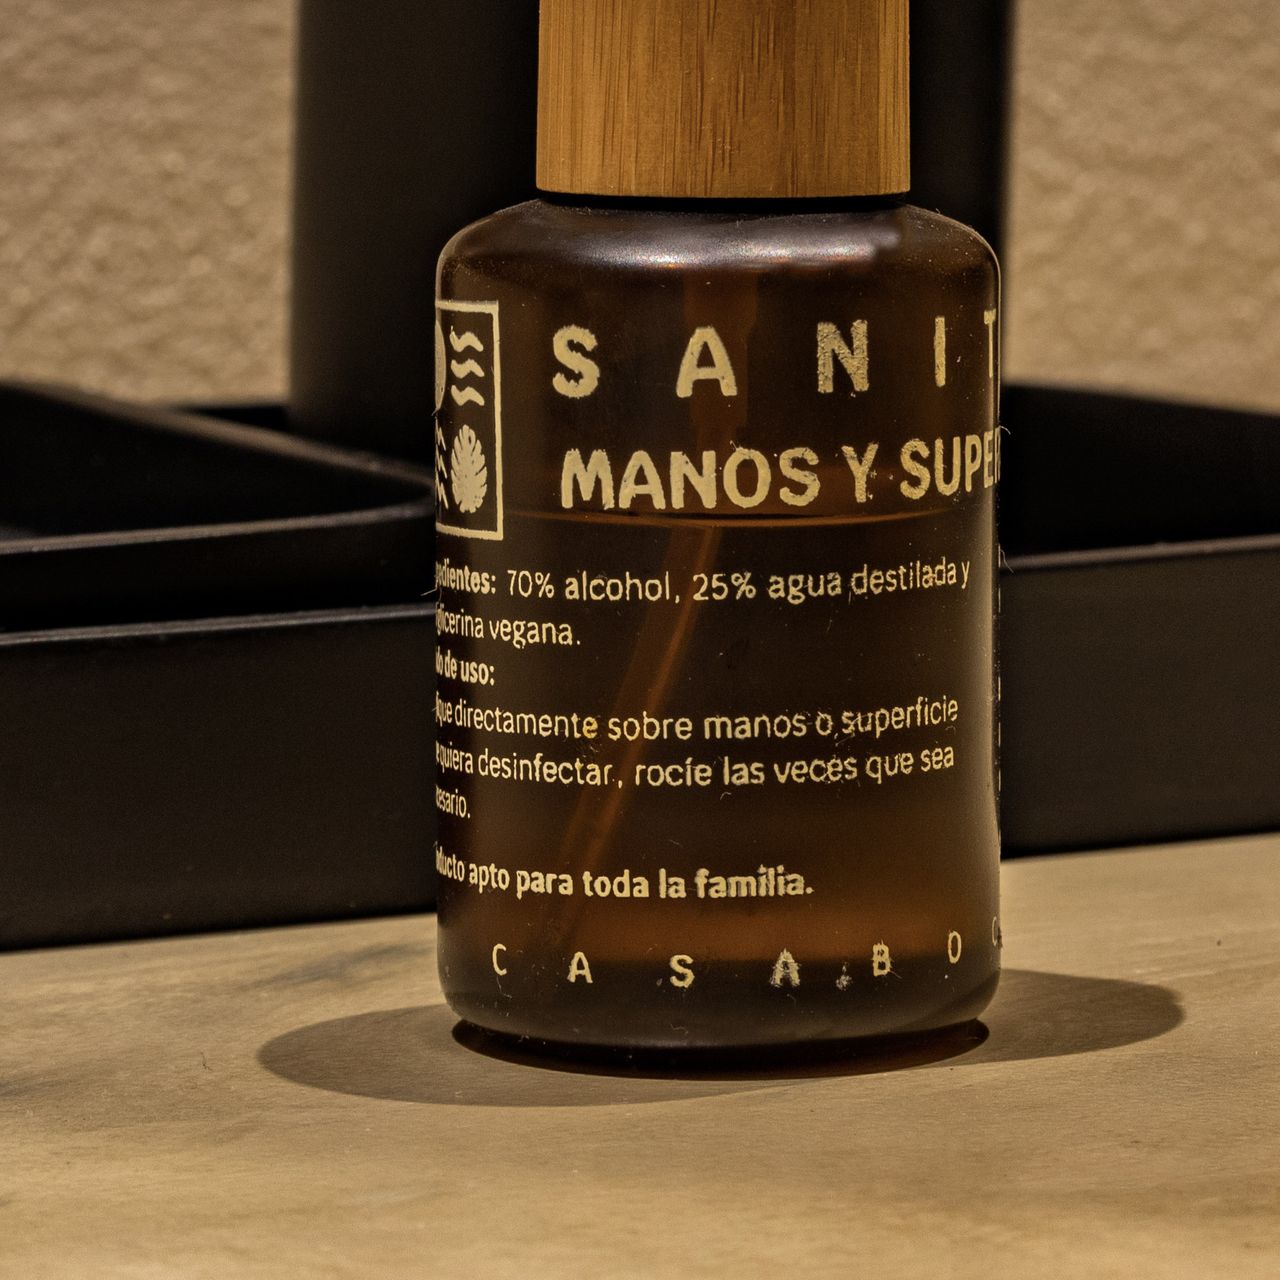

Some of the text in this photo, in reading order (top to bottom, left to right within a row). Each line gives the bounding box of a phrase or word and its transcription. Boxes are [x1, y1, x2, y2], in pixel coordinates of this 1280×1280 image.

[561, 446, 820, 509] MANOS
[842, 442, 878, 504] Y
[507, 570, 555, 598] 70%
[565, 571, 681, 604] alcohol,
[693, 571, 757, 601] 25%
[768, 572, 843, 605] agua
[851, 556, 958, 595] destilada
[961, 560, 971, 590] y
[489, 619, 581, 649] vegana.
[444, 649, 457, 680] de
[461, 660, 495, 686] uso:
[454, 698, 598, 739] directamente
[608, 710, 693, 741] sobre
[704, 714, 808, 740] manos
[841, 695, 959, 739] superficie
[478, 748, 623, 789] desinfectar,
[635, 757, 713, 787] rocíe
[723, 756, 765, 786] las
[774, 755, 858, 783] veces
[866, 752, 915, 784] que
[920, 746, 955, 772] sea
[468, 863, 510, 894] apto
[516, 870, 573, 900] para
[582, 868, 649, 898] toda
[658, 868, 686, 898] la
[694, 864, 814, 899] familia.
